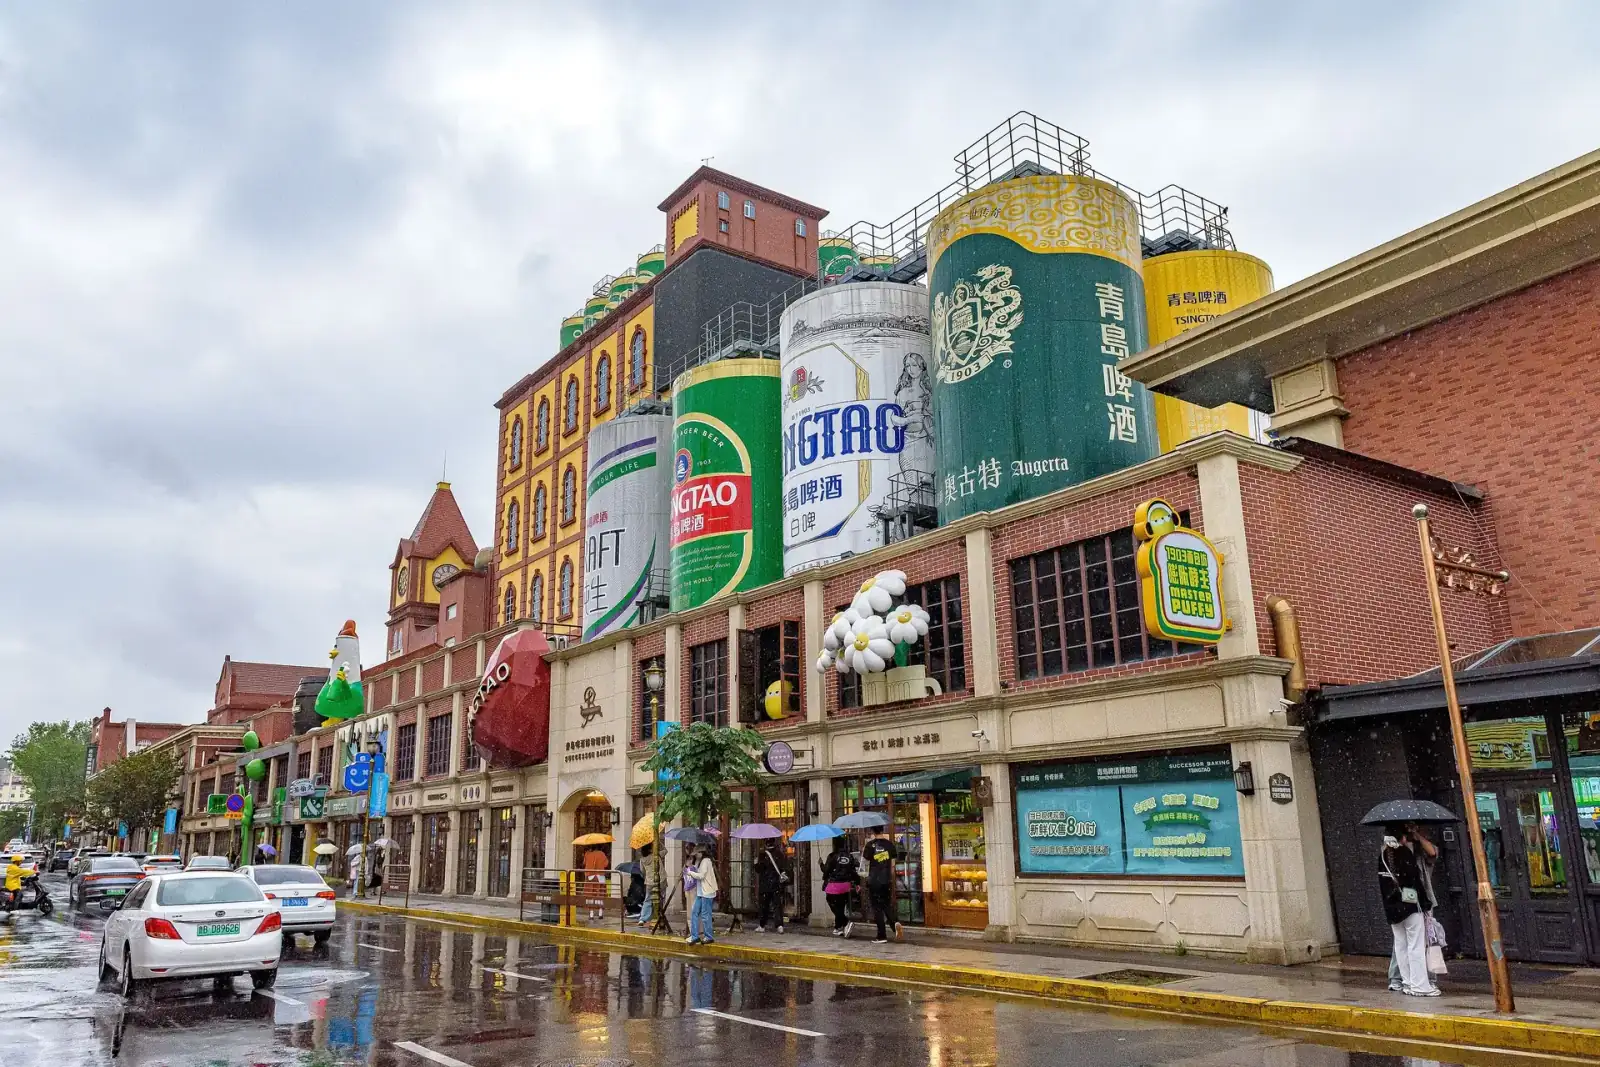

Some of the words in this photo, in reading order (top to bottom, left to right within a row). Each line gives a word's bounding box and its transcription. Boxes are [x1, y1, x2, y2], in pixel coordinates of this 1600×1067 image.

[950, 362, 981, 381] 1903
[702, 430, 724, 448] BEER
[597, 471, 614, 486] YOUR
[619, 461, 640, 474] LIFE
[1010, 457, 1070, 477] Augerta
[791, 511, 816, 538] 白啤
[693, 576, 713, 585] WORLD
[1171, 598, 1214, 619] PUFFY
[1029, 816, 1097, 837] 新鲜仅售8小时
[211, 923, 239, 934] D89626
